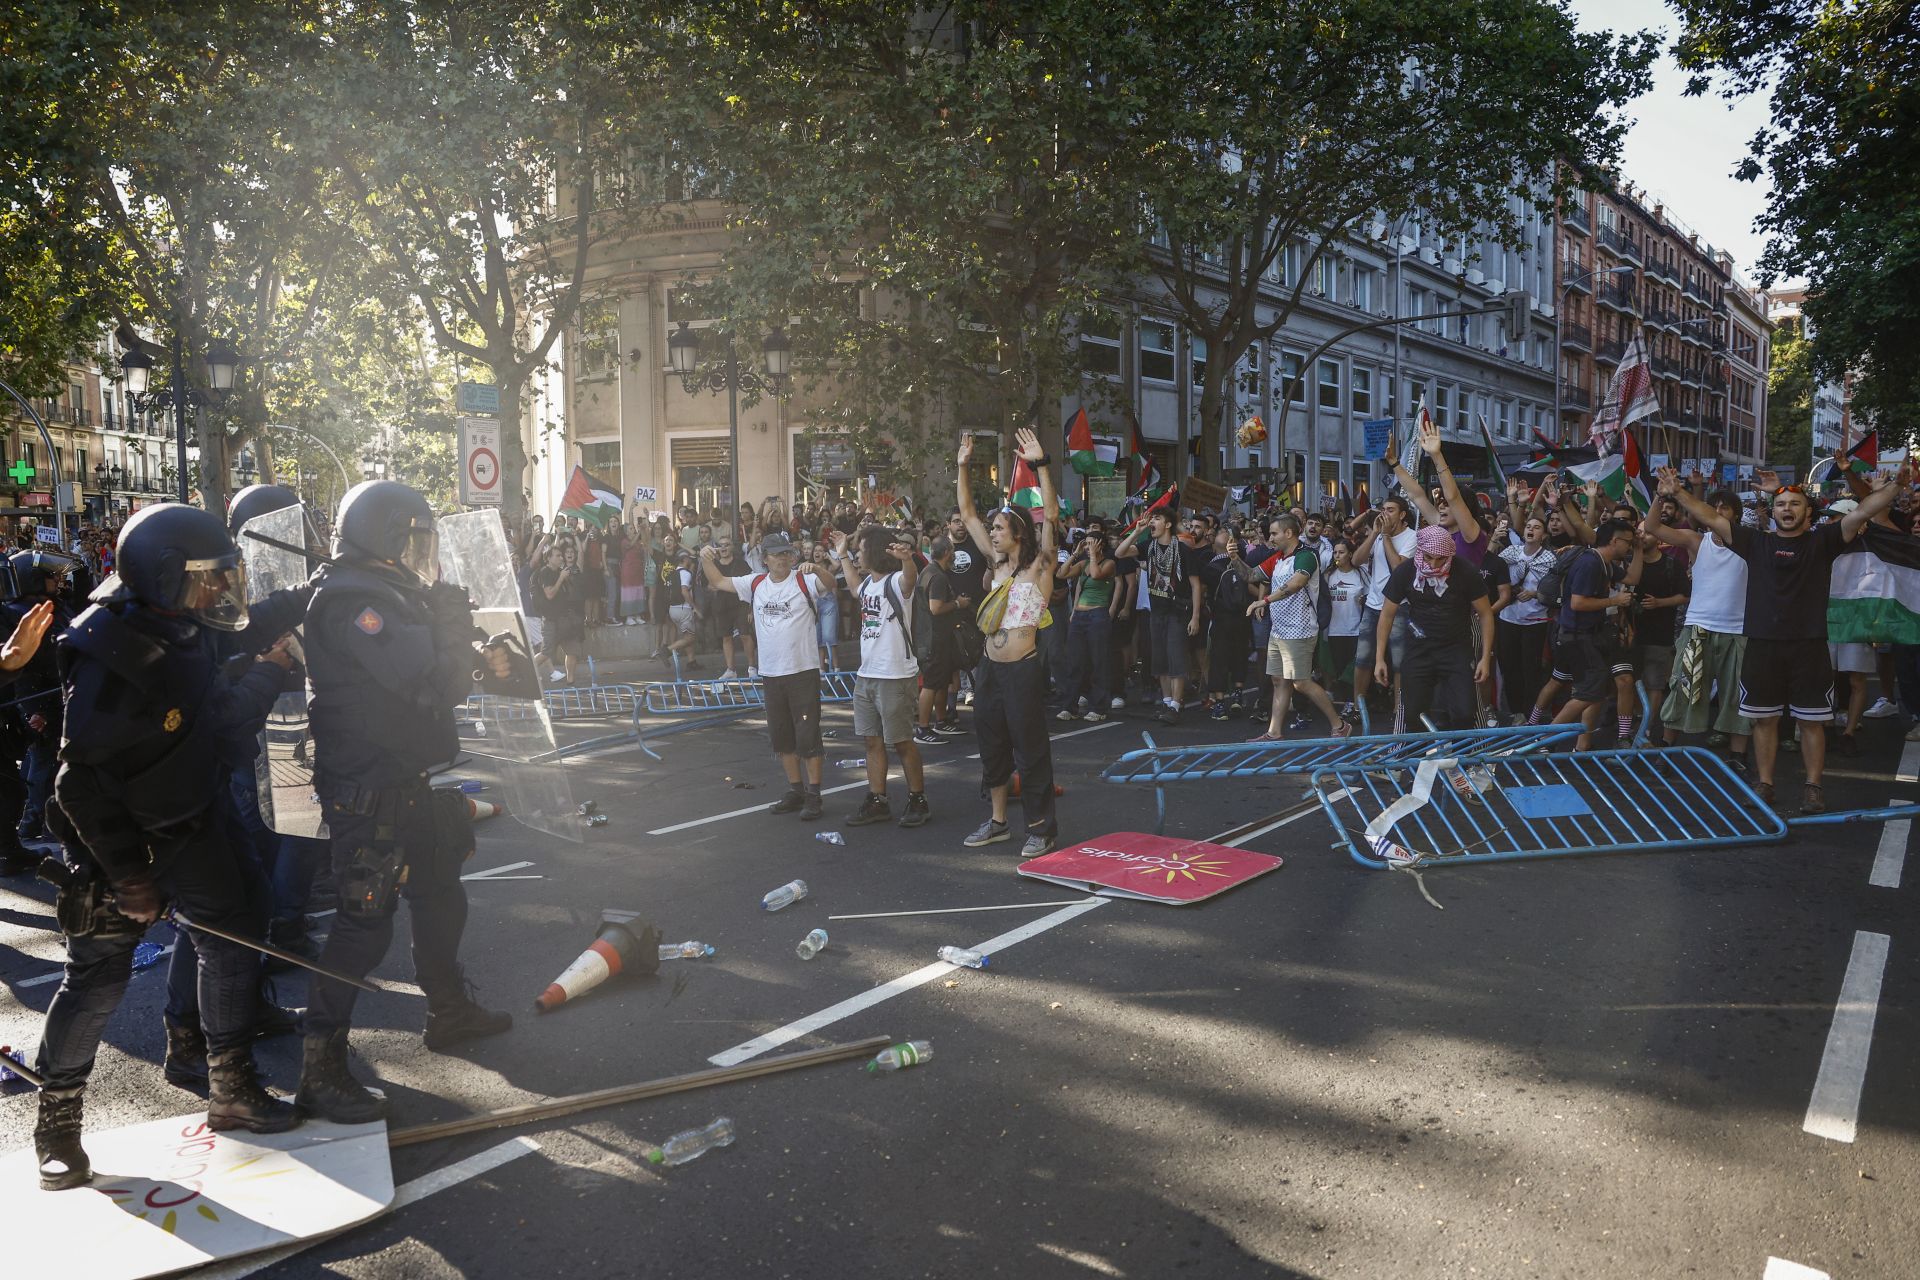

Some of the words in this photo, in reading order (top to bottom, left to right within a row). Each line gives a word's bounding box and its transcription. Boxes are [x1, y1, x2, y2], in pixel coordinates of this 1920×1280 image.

[637, 488, 656, 500] PAZ
[38, 527, 57, 535] JUSTICIA
[44, 535, 56, 543] PAZ
[1454, 775, 1467, 787] NO
[1078, 847, 1190, 870] Cofidis
